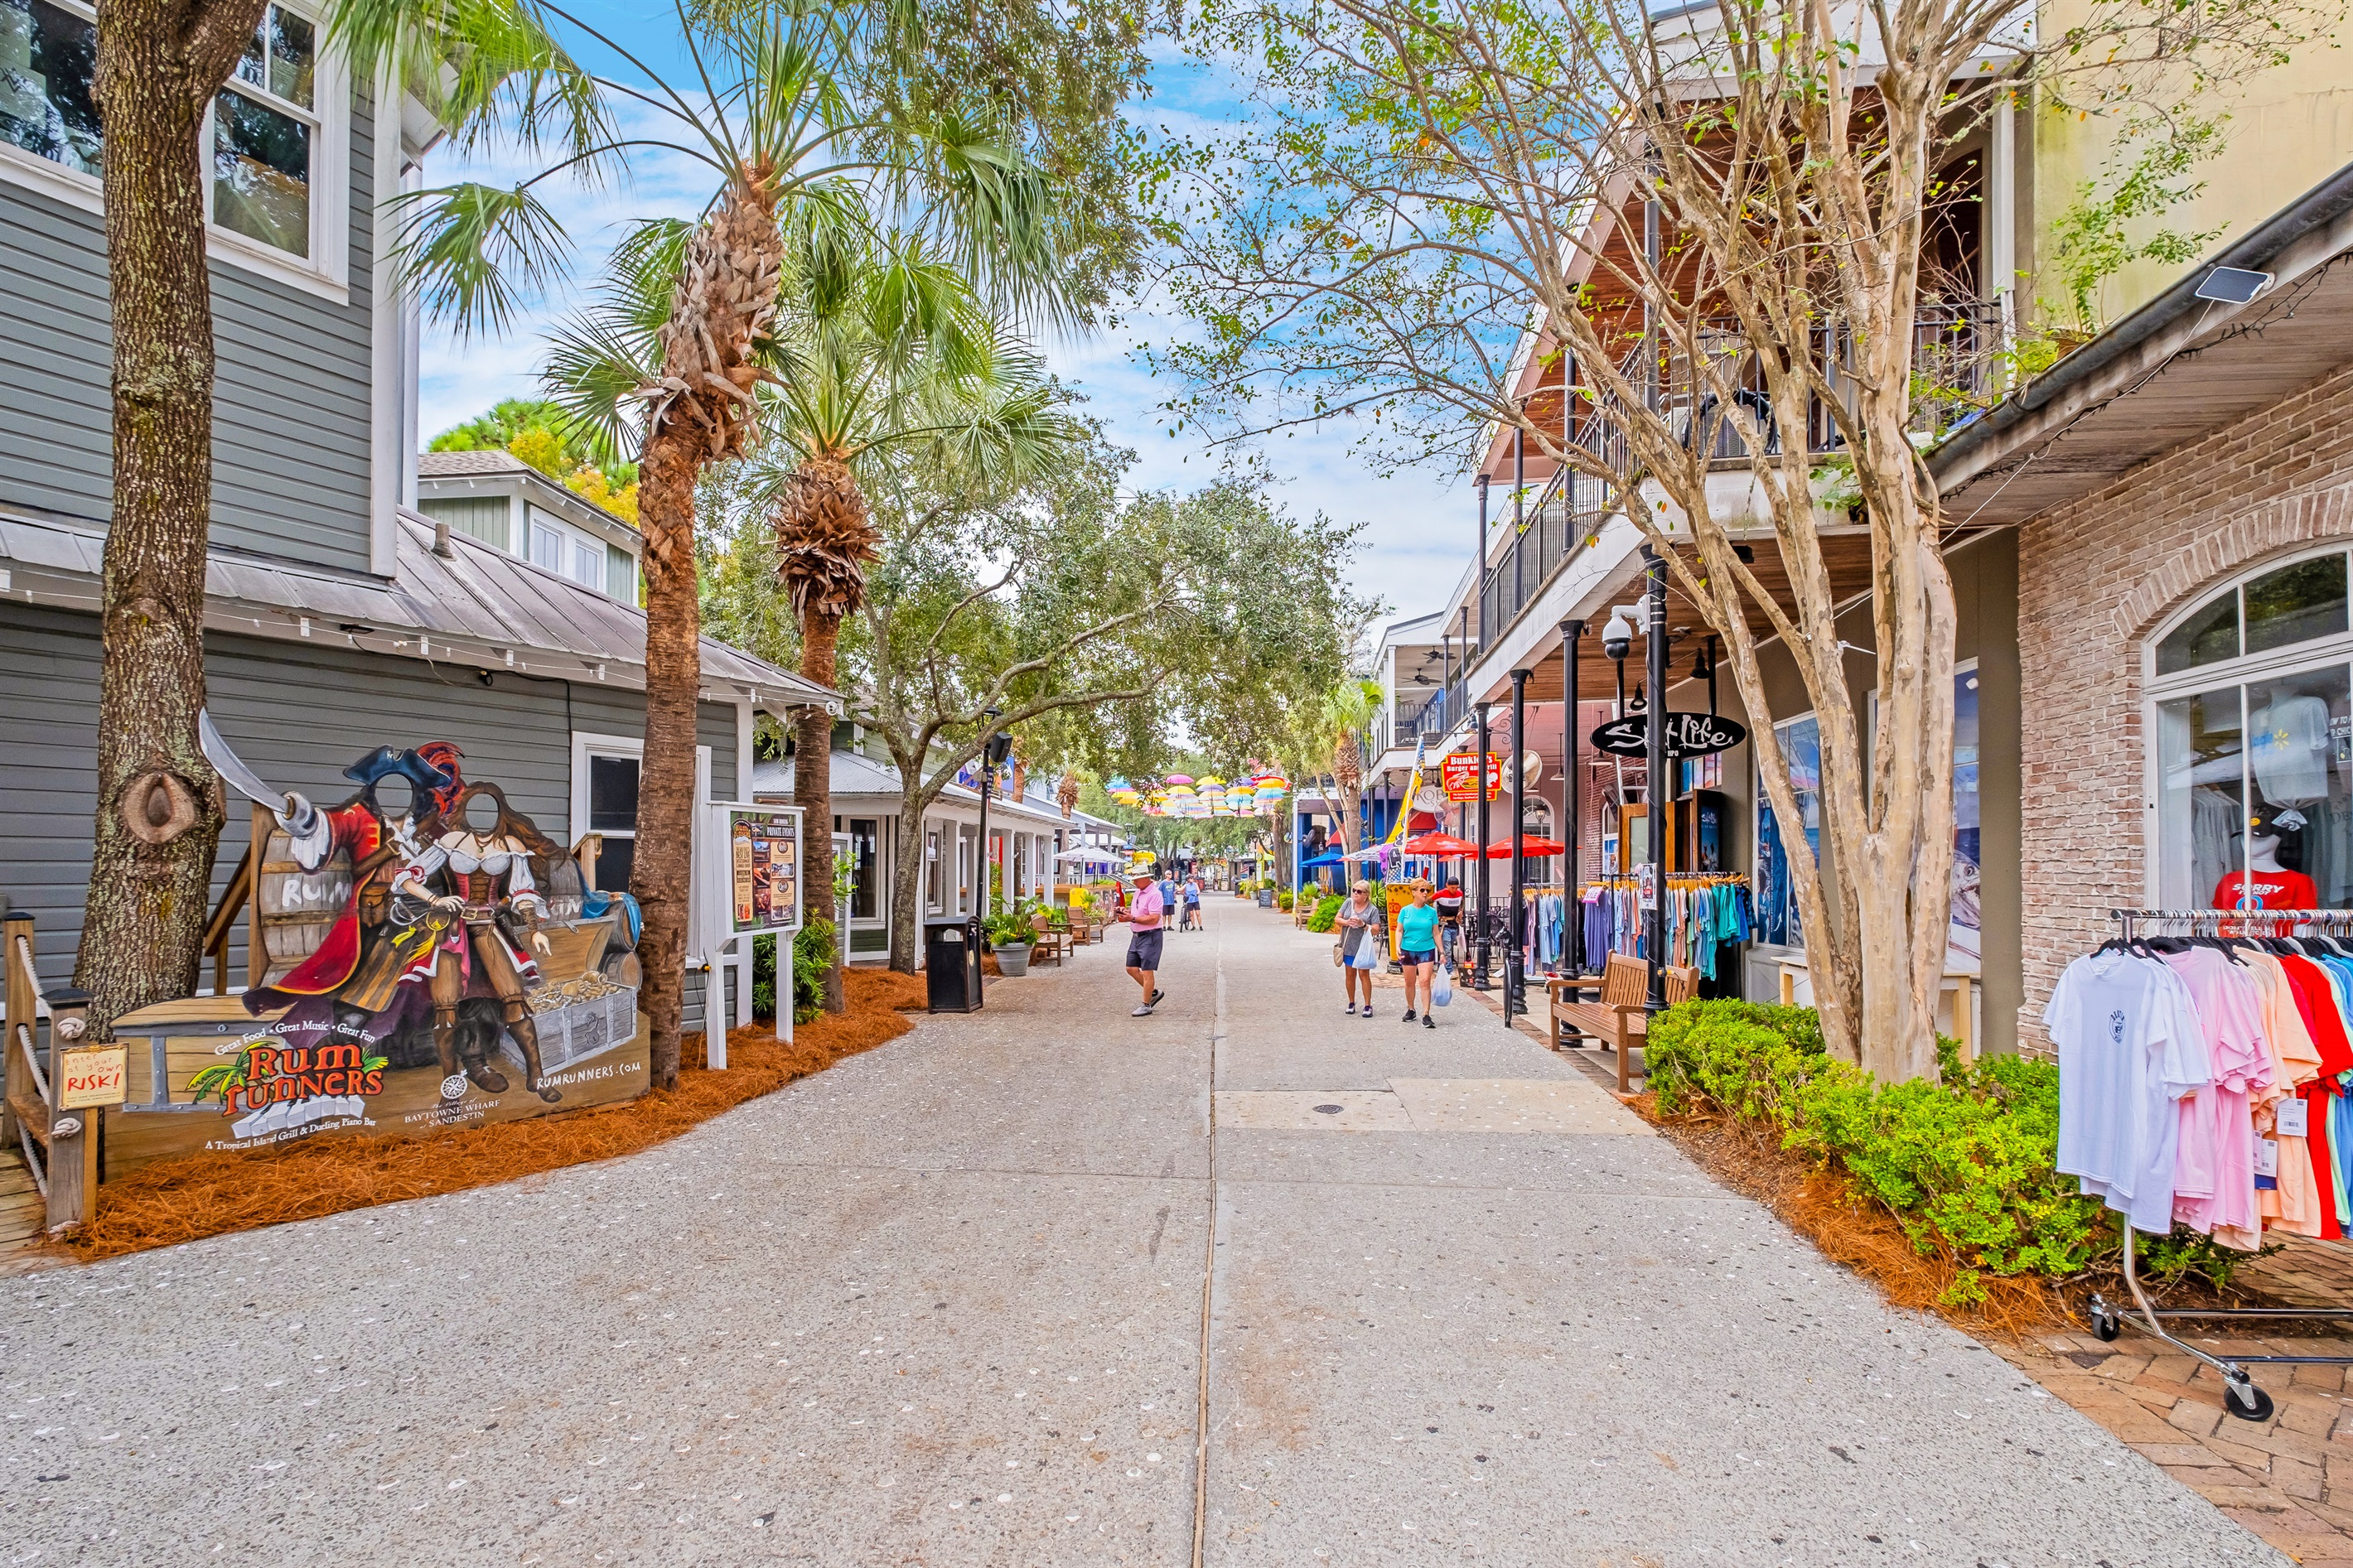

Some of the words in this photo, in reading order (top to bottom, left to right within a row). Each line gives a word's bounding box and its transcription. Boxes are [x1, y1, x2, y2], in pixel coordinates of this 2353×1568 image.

[1605, 723, 1679, 750] St
[1679, 715, 1732, 750] Life
[2336, 726, 2351, 736] CHIC
[1417, 789, 1447, 804] KOB
[282, 880, 351, 906] RUM
[215, 1040, 242, 1056] Great
[243, 1029, 266, 1044] Food
[275, 1023, 300, 1034] Great
[301, 1020, 329, 1031] Music
[336, 1023, 359, 1036] Great
[360, 1031, 376, 1044] Fun
[86, 1057, 113, 1071] your
[98, 1064, 123, 1073] own
[246, 1044, 363, 1081] Rum
[67, 1072, 120, 1092] RISK!
[536, 1062, 642, 1090] RUMRUNNERS.COM
[404, 1106, 463, 1123] BAYTOWNE
[465, 1099, 500, 1112] WHARF
[428, 1110, 485, 1127] SANDESTIN
[205, 1141, 213, 1150] A
[215, 1140, 251, 1152] Tropical
[253, 1132, 277, 1146] Island
[278, 1129, 298, 1141] Grill
[299, 1127, 307, 1135] &
[309, 1120, 340, 1133] Dueling
[341, 1118, 362, 1127] Piano
[364, 1117, 376, 1127] Bar
